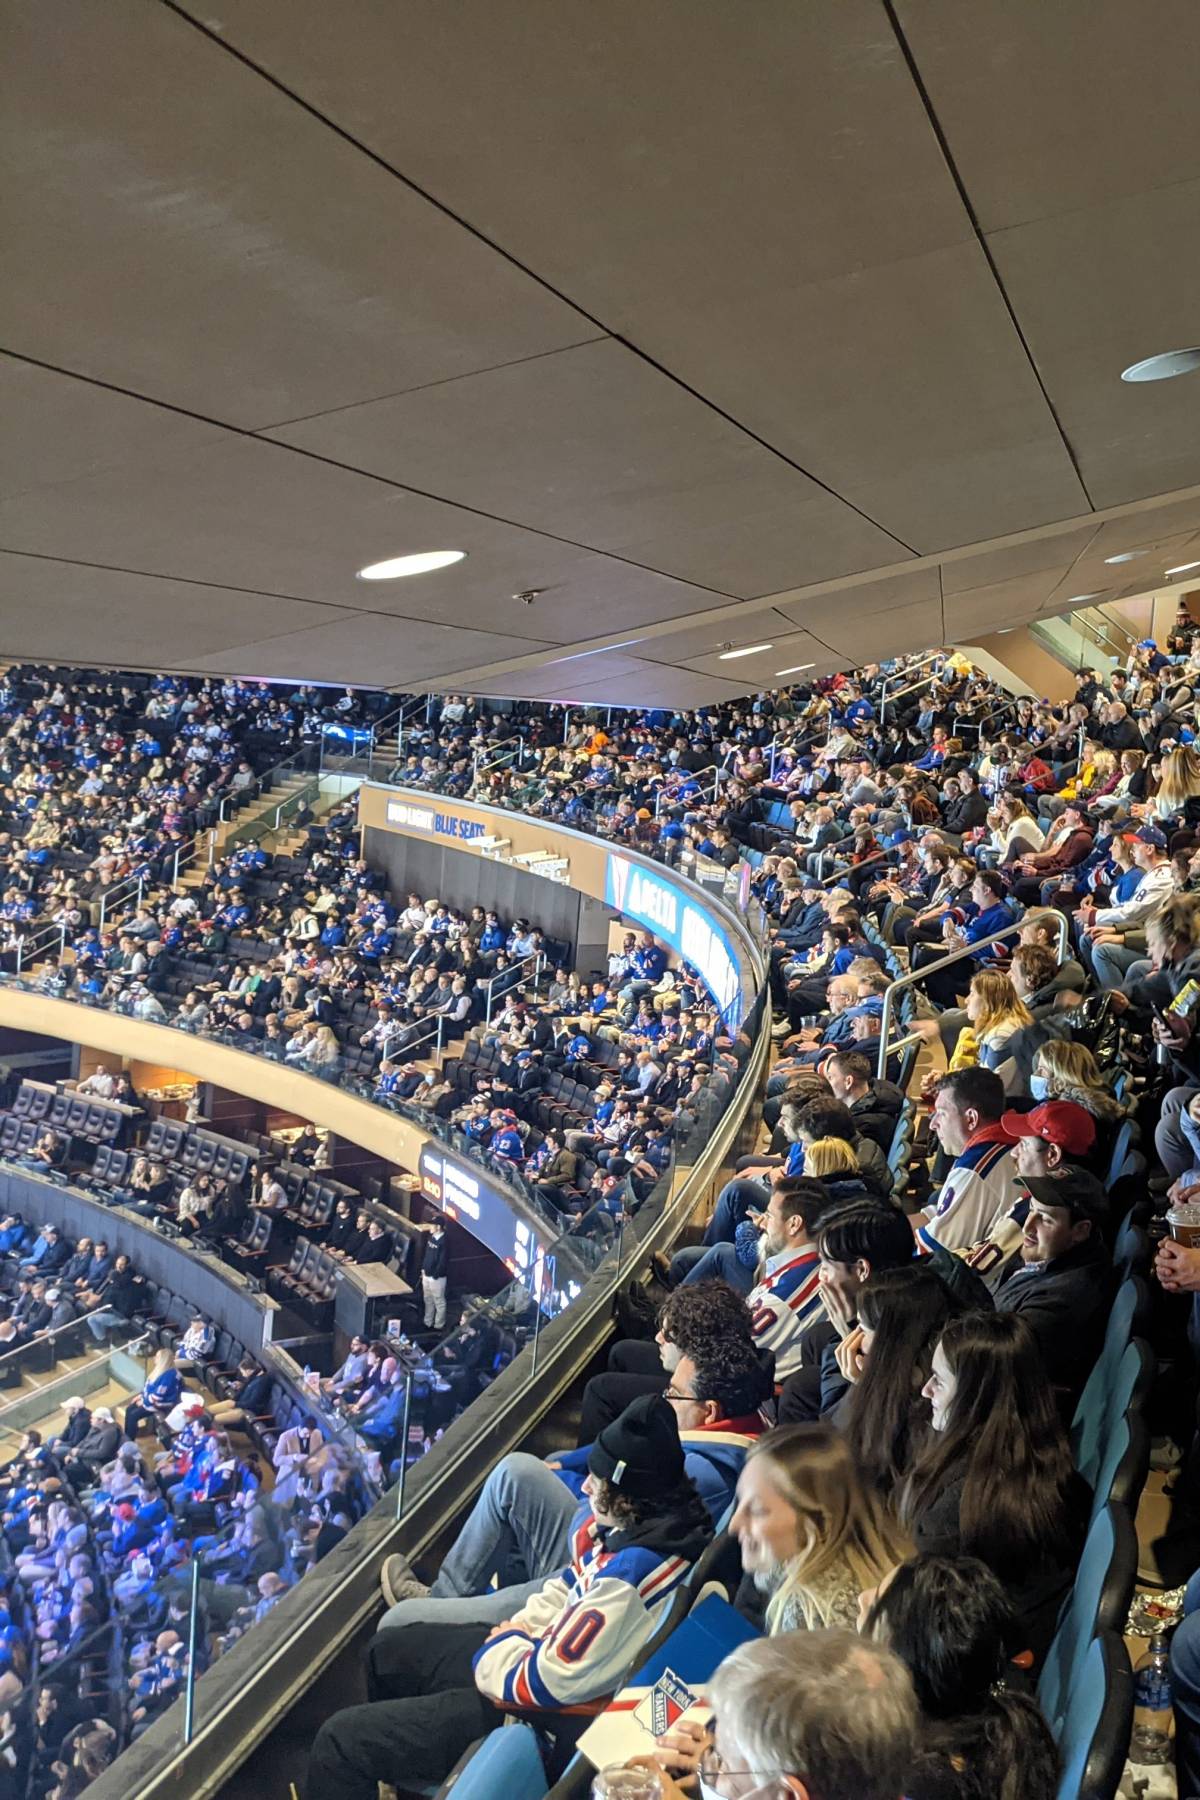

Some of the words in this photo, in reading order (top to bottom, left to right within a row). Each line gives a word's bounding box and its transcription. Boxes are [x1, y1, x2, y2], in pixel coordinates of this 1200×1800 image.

[434, 813, 458, 837] BLUE
[458, 819, 486, 840] SEATS
[640, 879, 676, 934] DELTA
[659, 1676, 678, 1694] NEW
[673, 1687, 692, 1710] YORK
[654, 1692, 666, 1735] RANGERS
